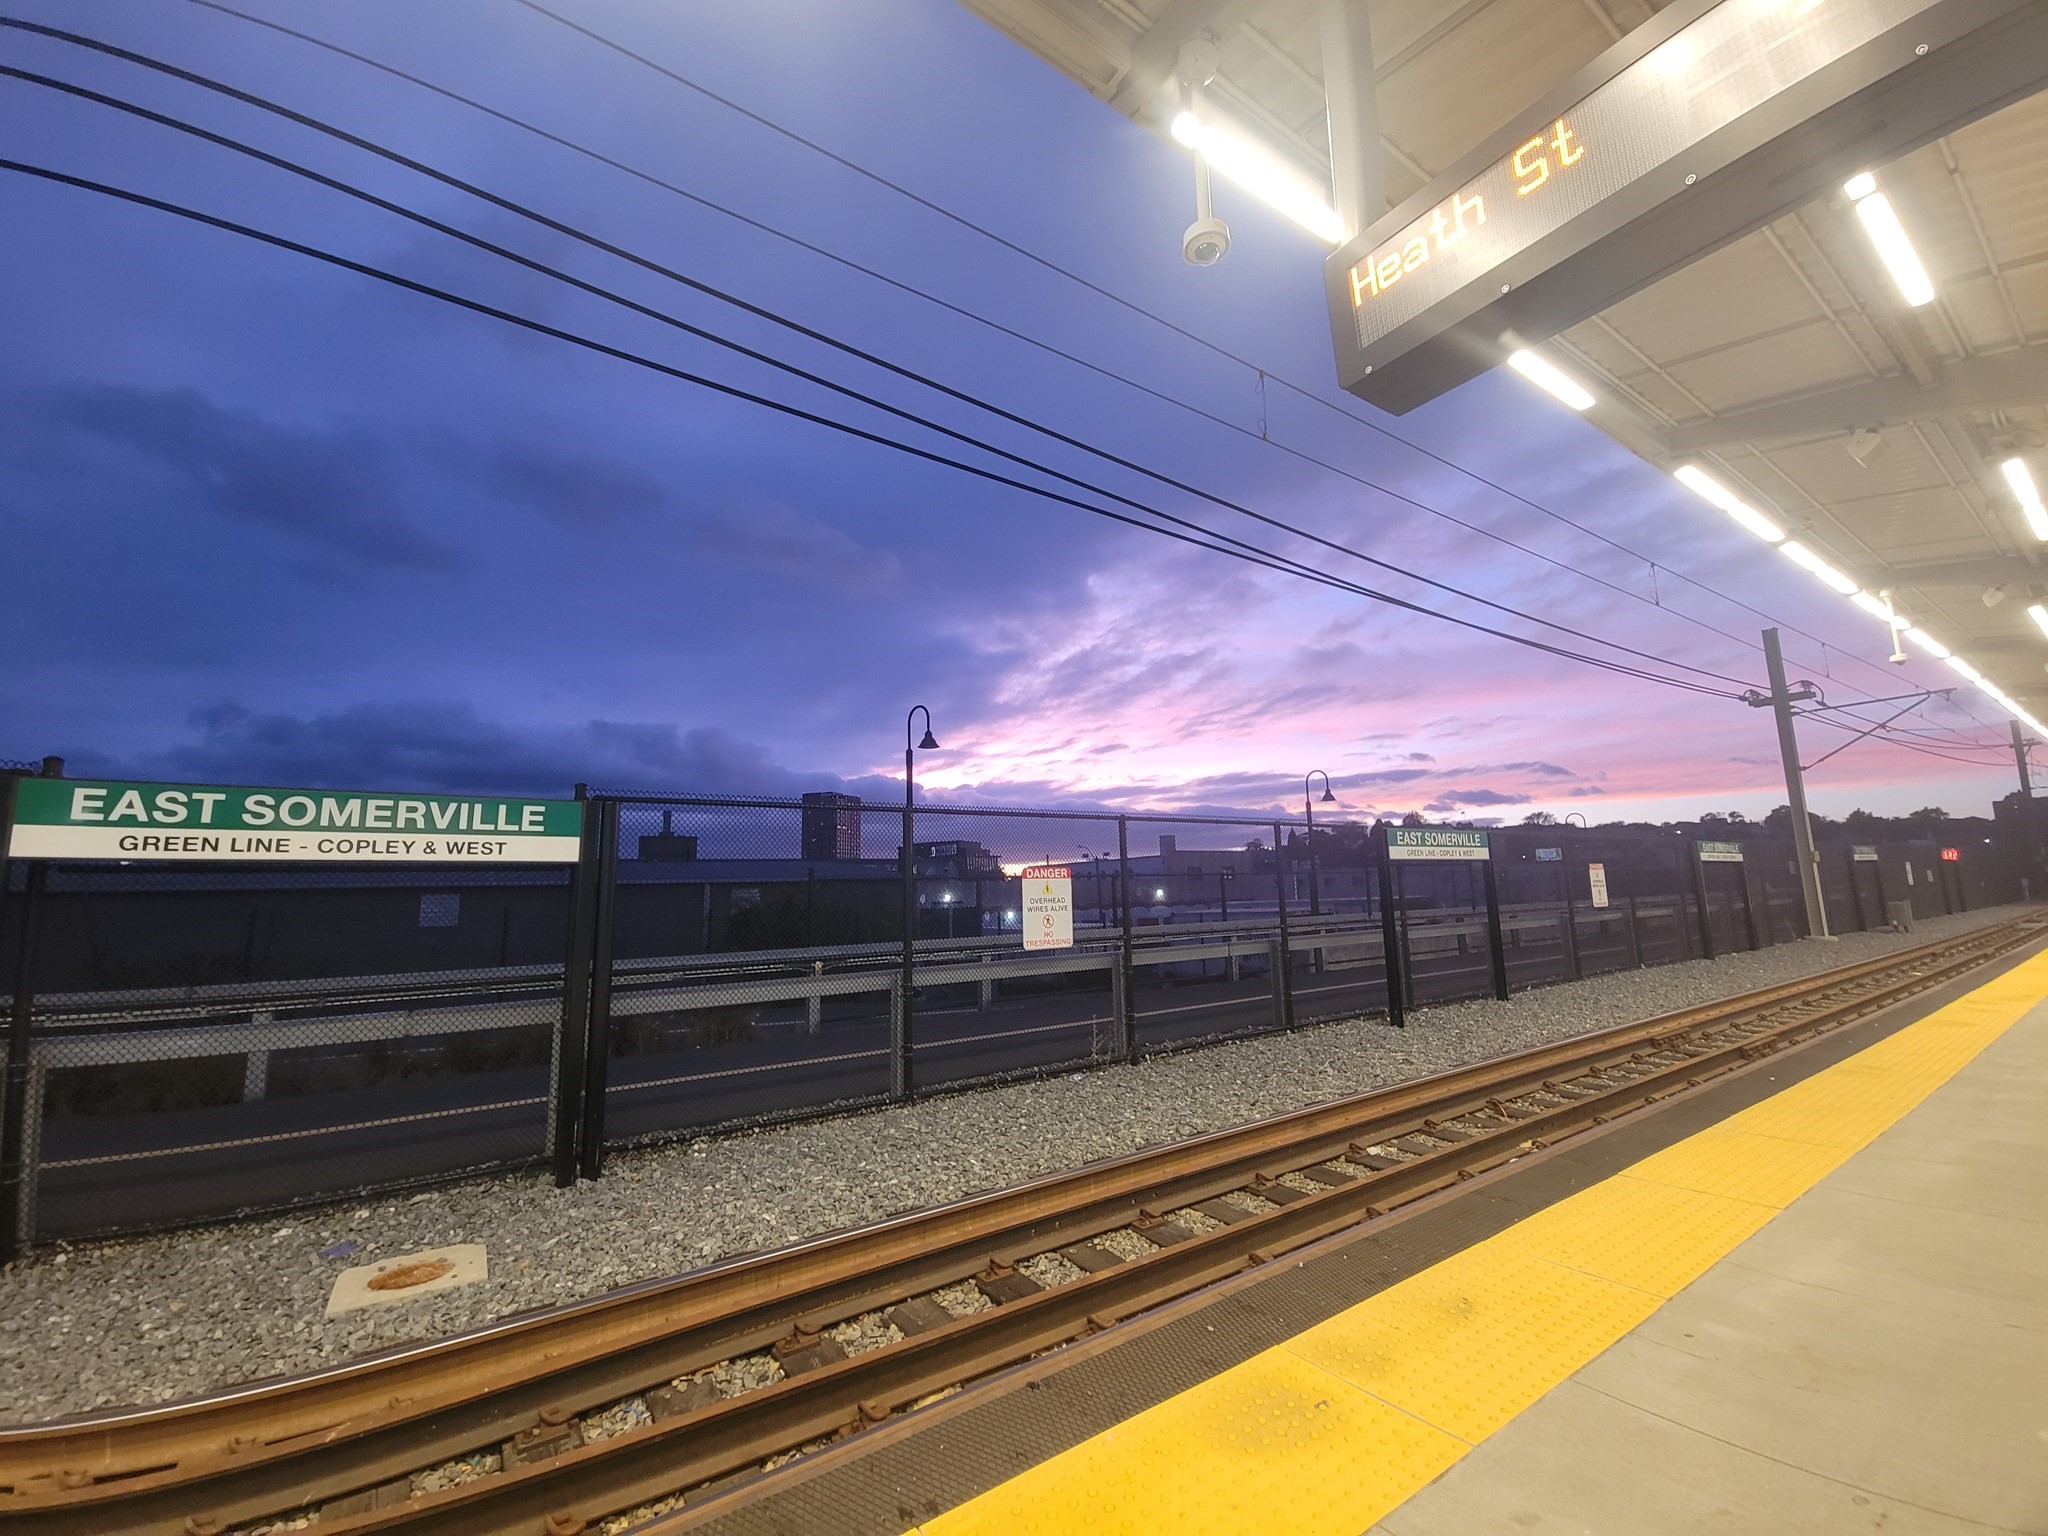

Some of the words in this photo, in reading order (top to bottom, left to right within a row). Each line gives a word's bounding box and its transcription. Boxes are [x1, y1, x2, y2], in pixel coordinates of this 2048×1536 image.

[1350, 193, 1487, 307] Heath
[1512, 119, 1584, 196] St
[70, 787, 227, 824] EAST
[241, 794, 546, 832] SOMERVILLE
[1396, 831, 1422, 845] EAST
[1424, 832, 1481, 846] SOMERVILLE
[118, 835, 220, 852] GREEN
[230, 837, 291, 853] LINE
[317, 838, 417, 855] COPLEY
[422, 841, 438, 855] &
[446, 841, 508, 856] WEST
[1406, 849, 1424, 857] GREEN
[1425, 849, 1436, 857] LINE
[1439, 849, 1458, 857] COPLEY
[1026, 868, 1068, 878] DANGER
[1029, 897, 1066, 905] OVERHEAD
[1027, 905, 1049, 913] WIRES
[1050, 904, 1069, 912] ALIVE
[1026, 938, 1071, 947] TRESPASSING
